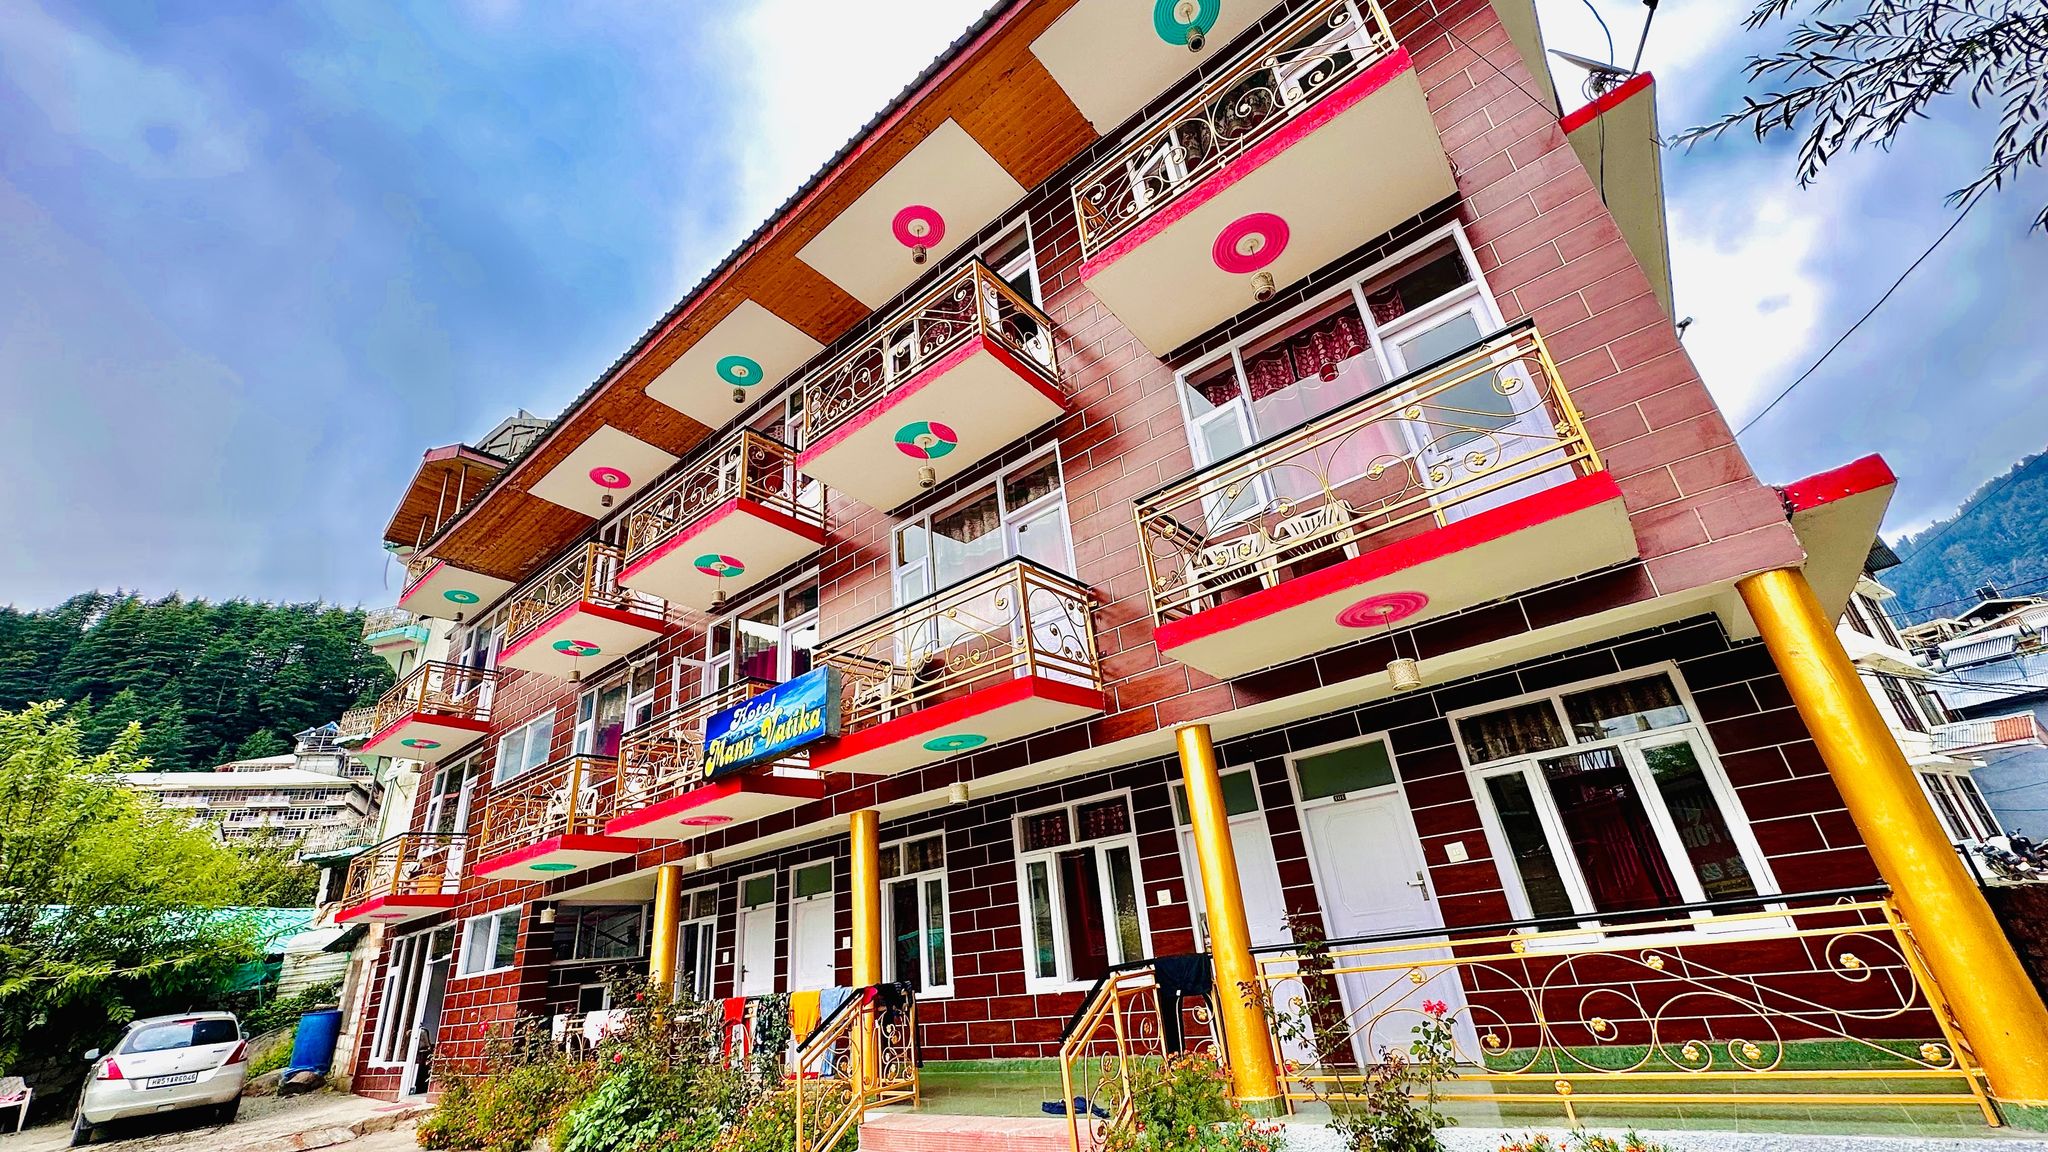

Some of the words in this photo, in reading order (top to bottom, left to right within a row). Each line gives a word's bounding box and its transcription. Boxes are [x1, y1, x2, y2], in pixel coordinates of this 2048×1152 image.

[705, 736, 754, 777] Manu
[761, 703, 820, 748] Vatika
[730, 693, 776, 731] Hotel
